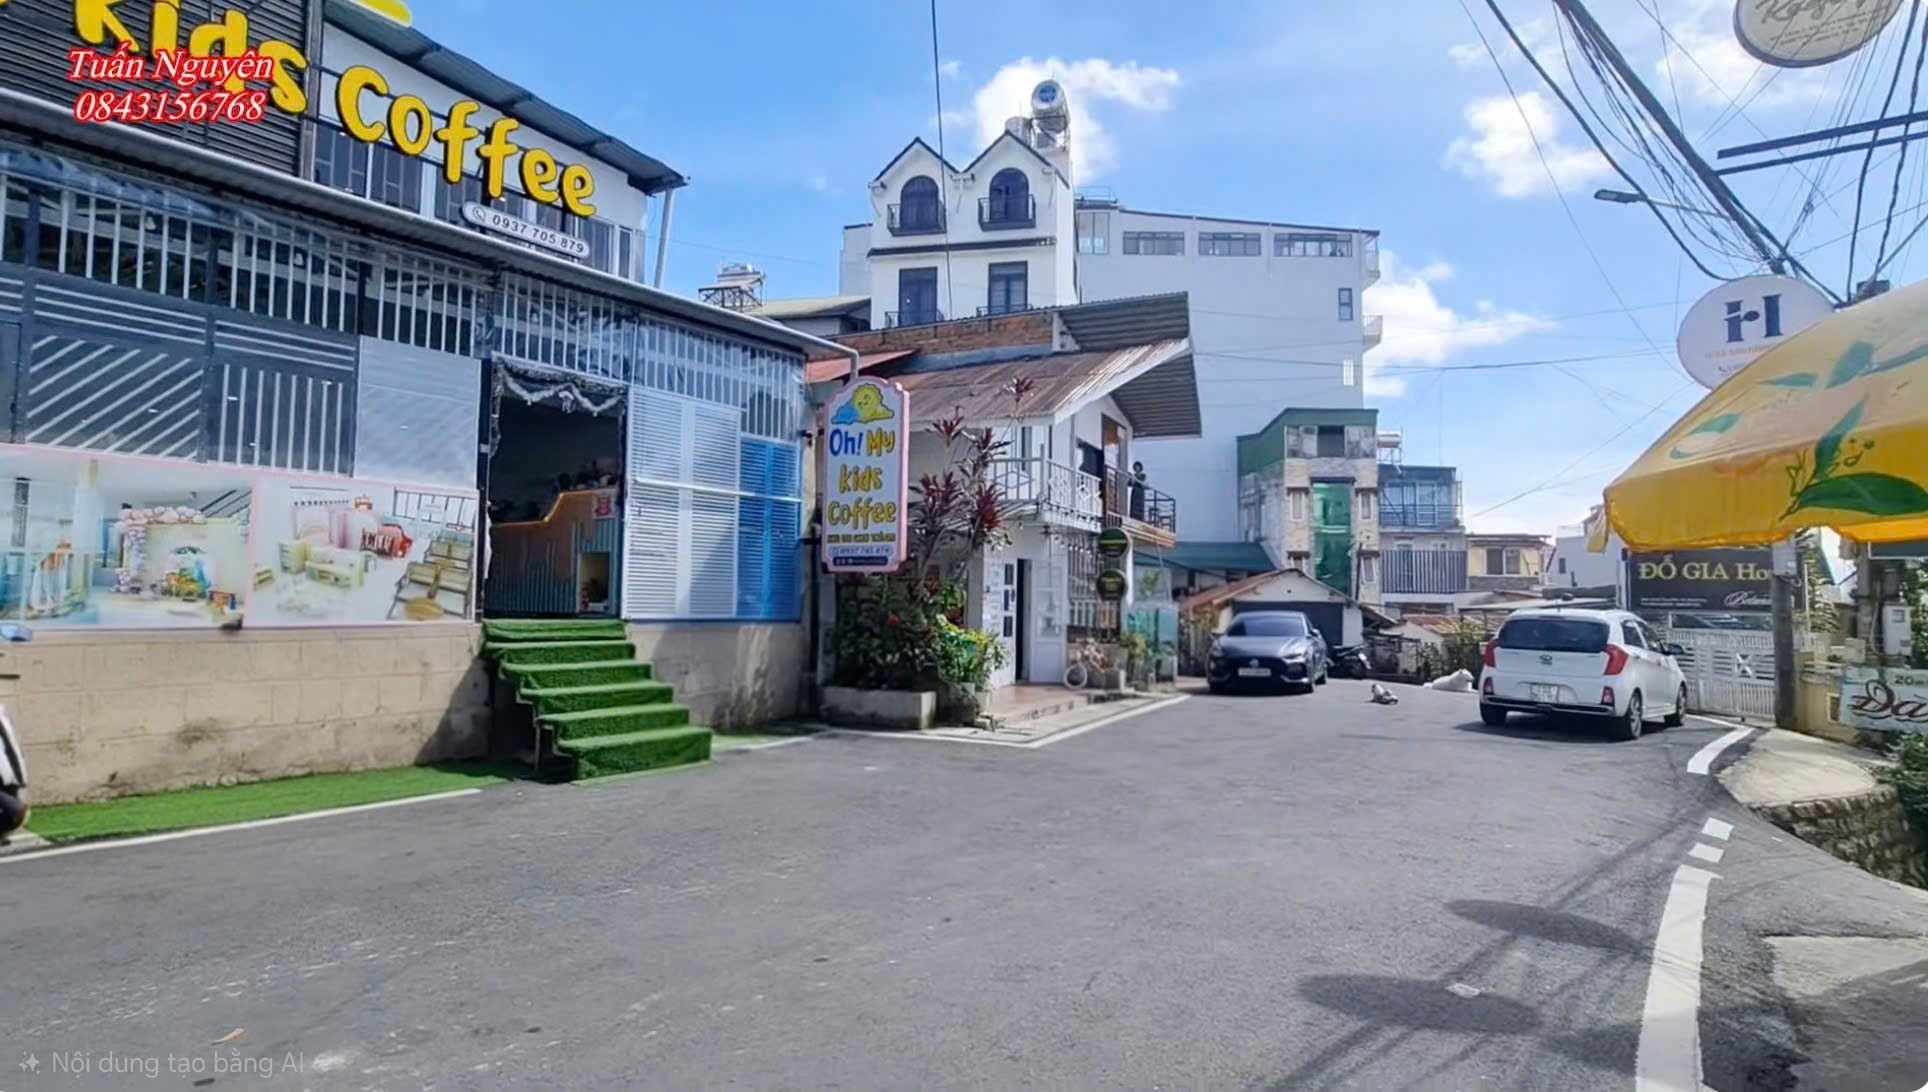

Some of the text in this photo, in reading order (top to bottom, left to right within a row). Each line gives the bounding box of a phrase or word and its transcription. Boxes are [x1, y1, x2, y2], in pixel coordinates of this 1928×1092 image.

[491, 213, 585, 255] 0937 705 879
[829, 427, 896, 457] Oh! My
[1682, 562, 1729, 580] GIA
[1736, 563, 1774, 581] Ho
